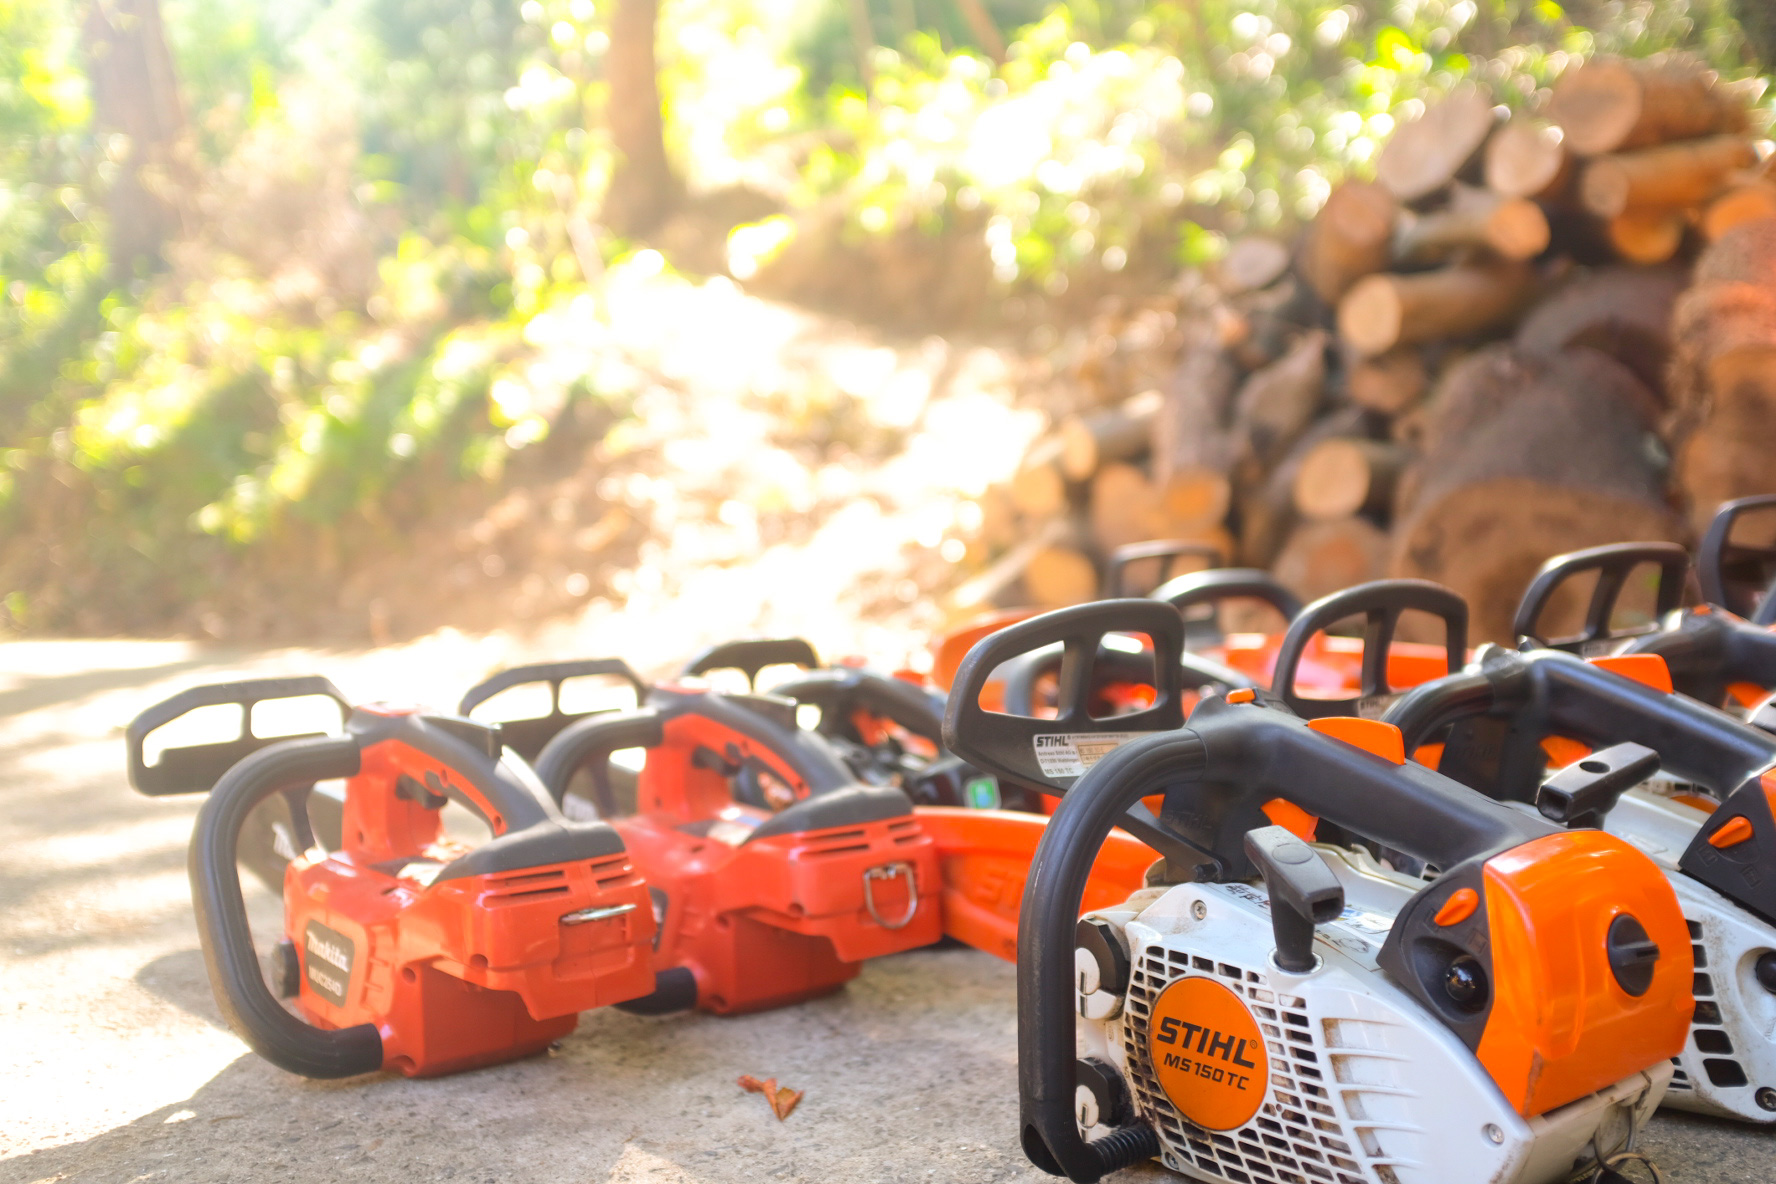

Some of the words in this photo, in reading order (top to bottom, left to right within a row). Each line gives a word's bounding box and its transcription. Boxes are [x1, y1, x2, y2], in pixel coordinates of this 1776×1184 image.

[1036, 735, 1069, 747] STIHL
[1156, 1016, 1256, 1070] STIHL
[1163, 1052, 1192, 1073] MS
[1194, 1062, 1225, 1083] 150
[1227, 1072, 1250, 1091] TC
